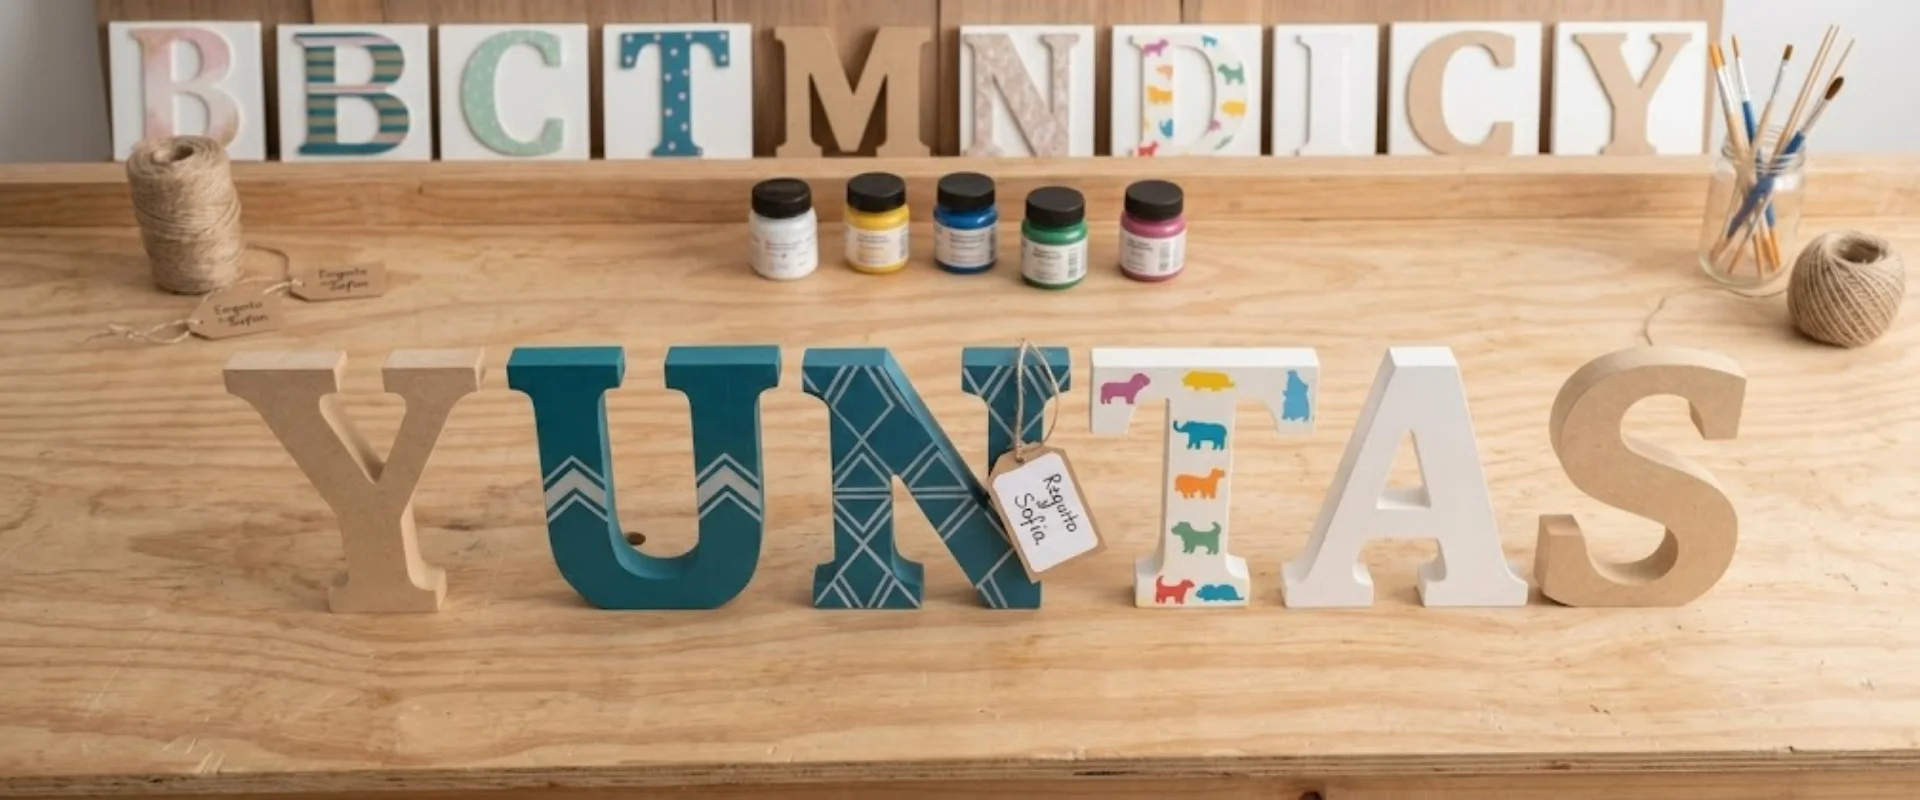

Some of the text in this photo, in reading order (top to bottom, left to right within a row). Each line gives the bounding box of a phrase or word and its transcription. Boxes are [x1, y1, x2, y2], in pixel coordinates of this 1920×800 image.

[129, 28, 239, 151] B
[292, 32, 410, 155] B
[460, 30, 564, 156] C
[620, 31, 729, 156] T
[774, 26, 931, 157] M
[964, 33, 1079, 157] N
[1128, 33, 1249, 157] D
[1405, 30, 1515, 156] C
[1573, 32, 1692, 156] Y
[223, 346, 1746, 610] YUNTAS
